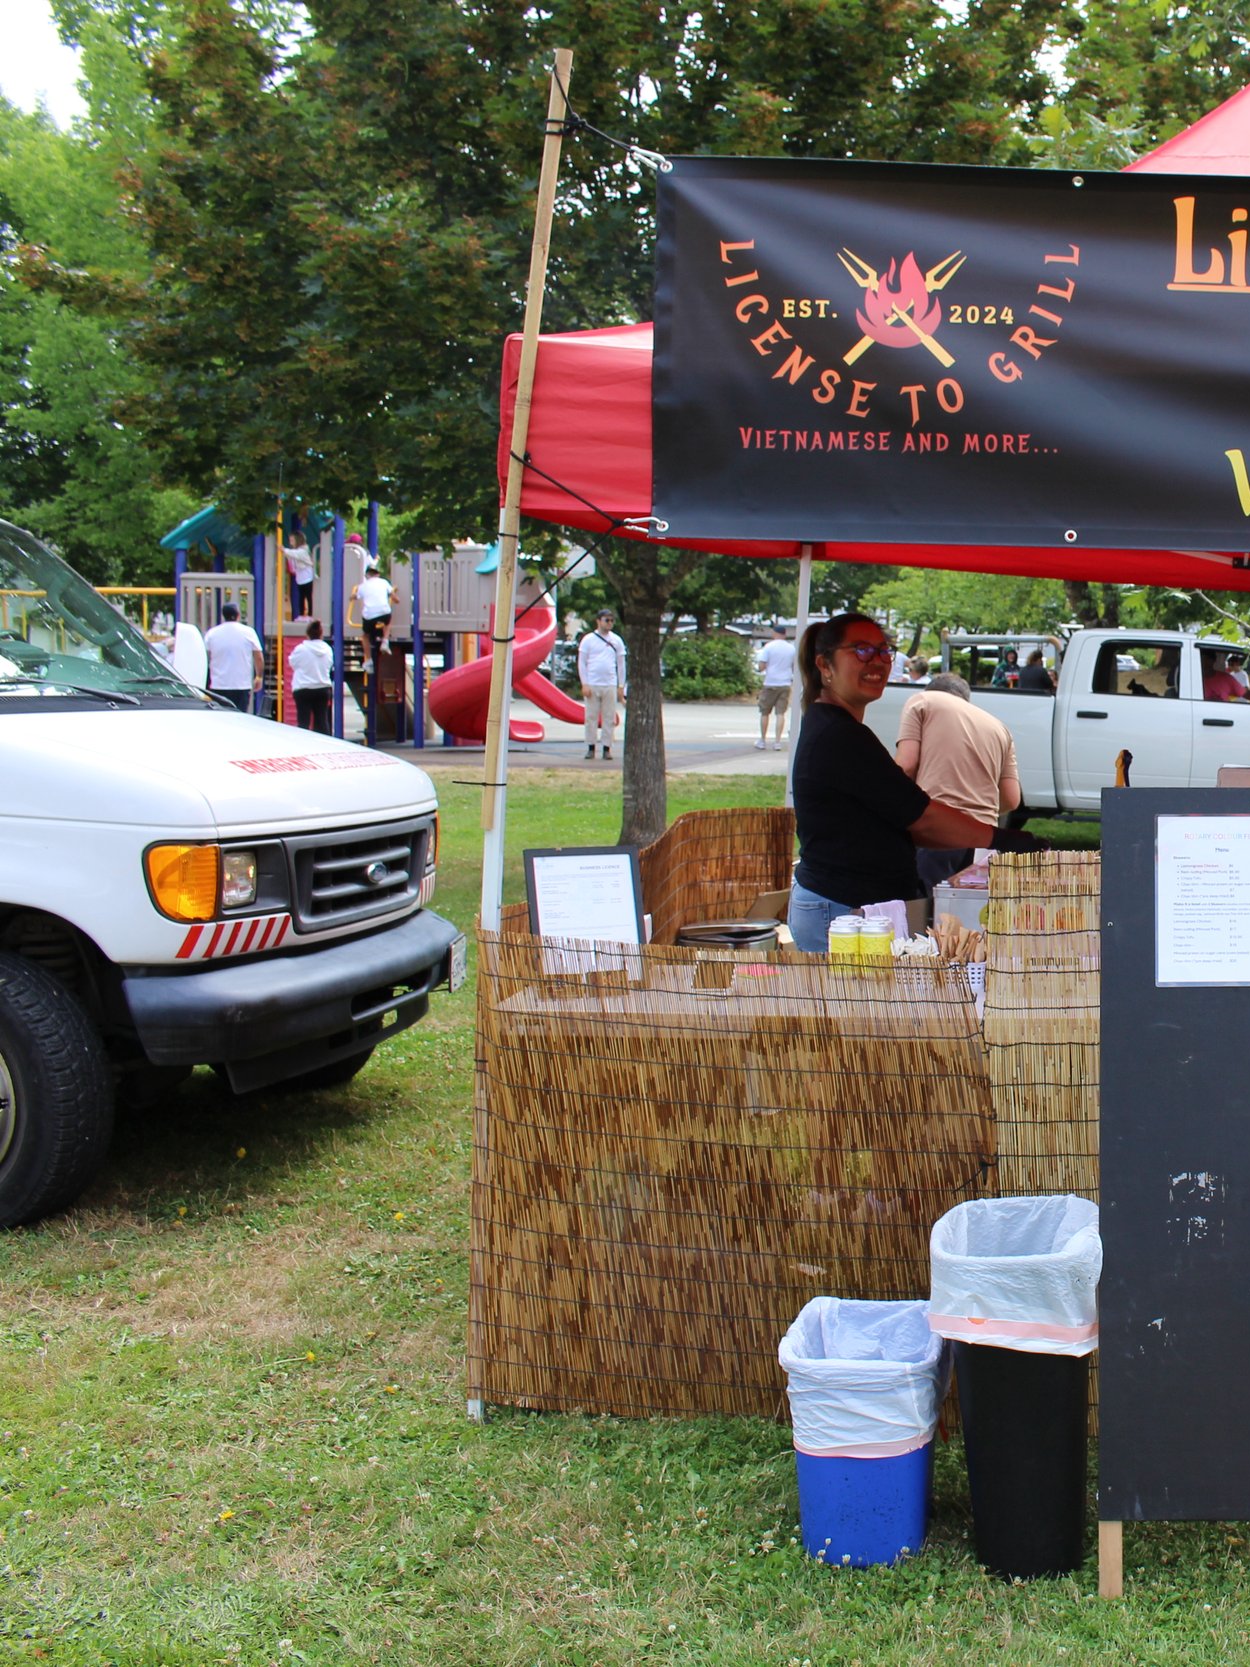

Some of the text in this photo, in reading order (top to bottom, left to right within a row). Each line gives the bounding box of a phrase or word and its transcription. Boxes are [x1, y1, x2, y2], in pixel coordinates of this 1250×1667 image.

[782, 299, 839, 319] EST.
[948, 305, 1015, 325] 2024
[720, 239, 1081, 428] LICENSE TO GRILL
[739, 427, 891, 453] VIETNAMESE
[901, 432, 950, 454] AND
